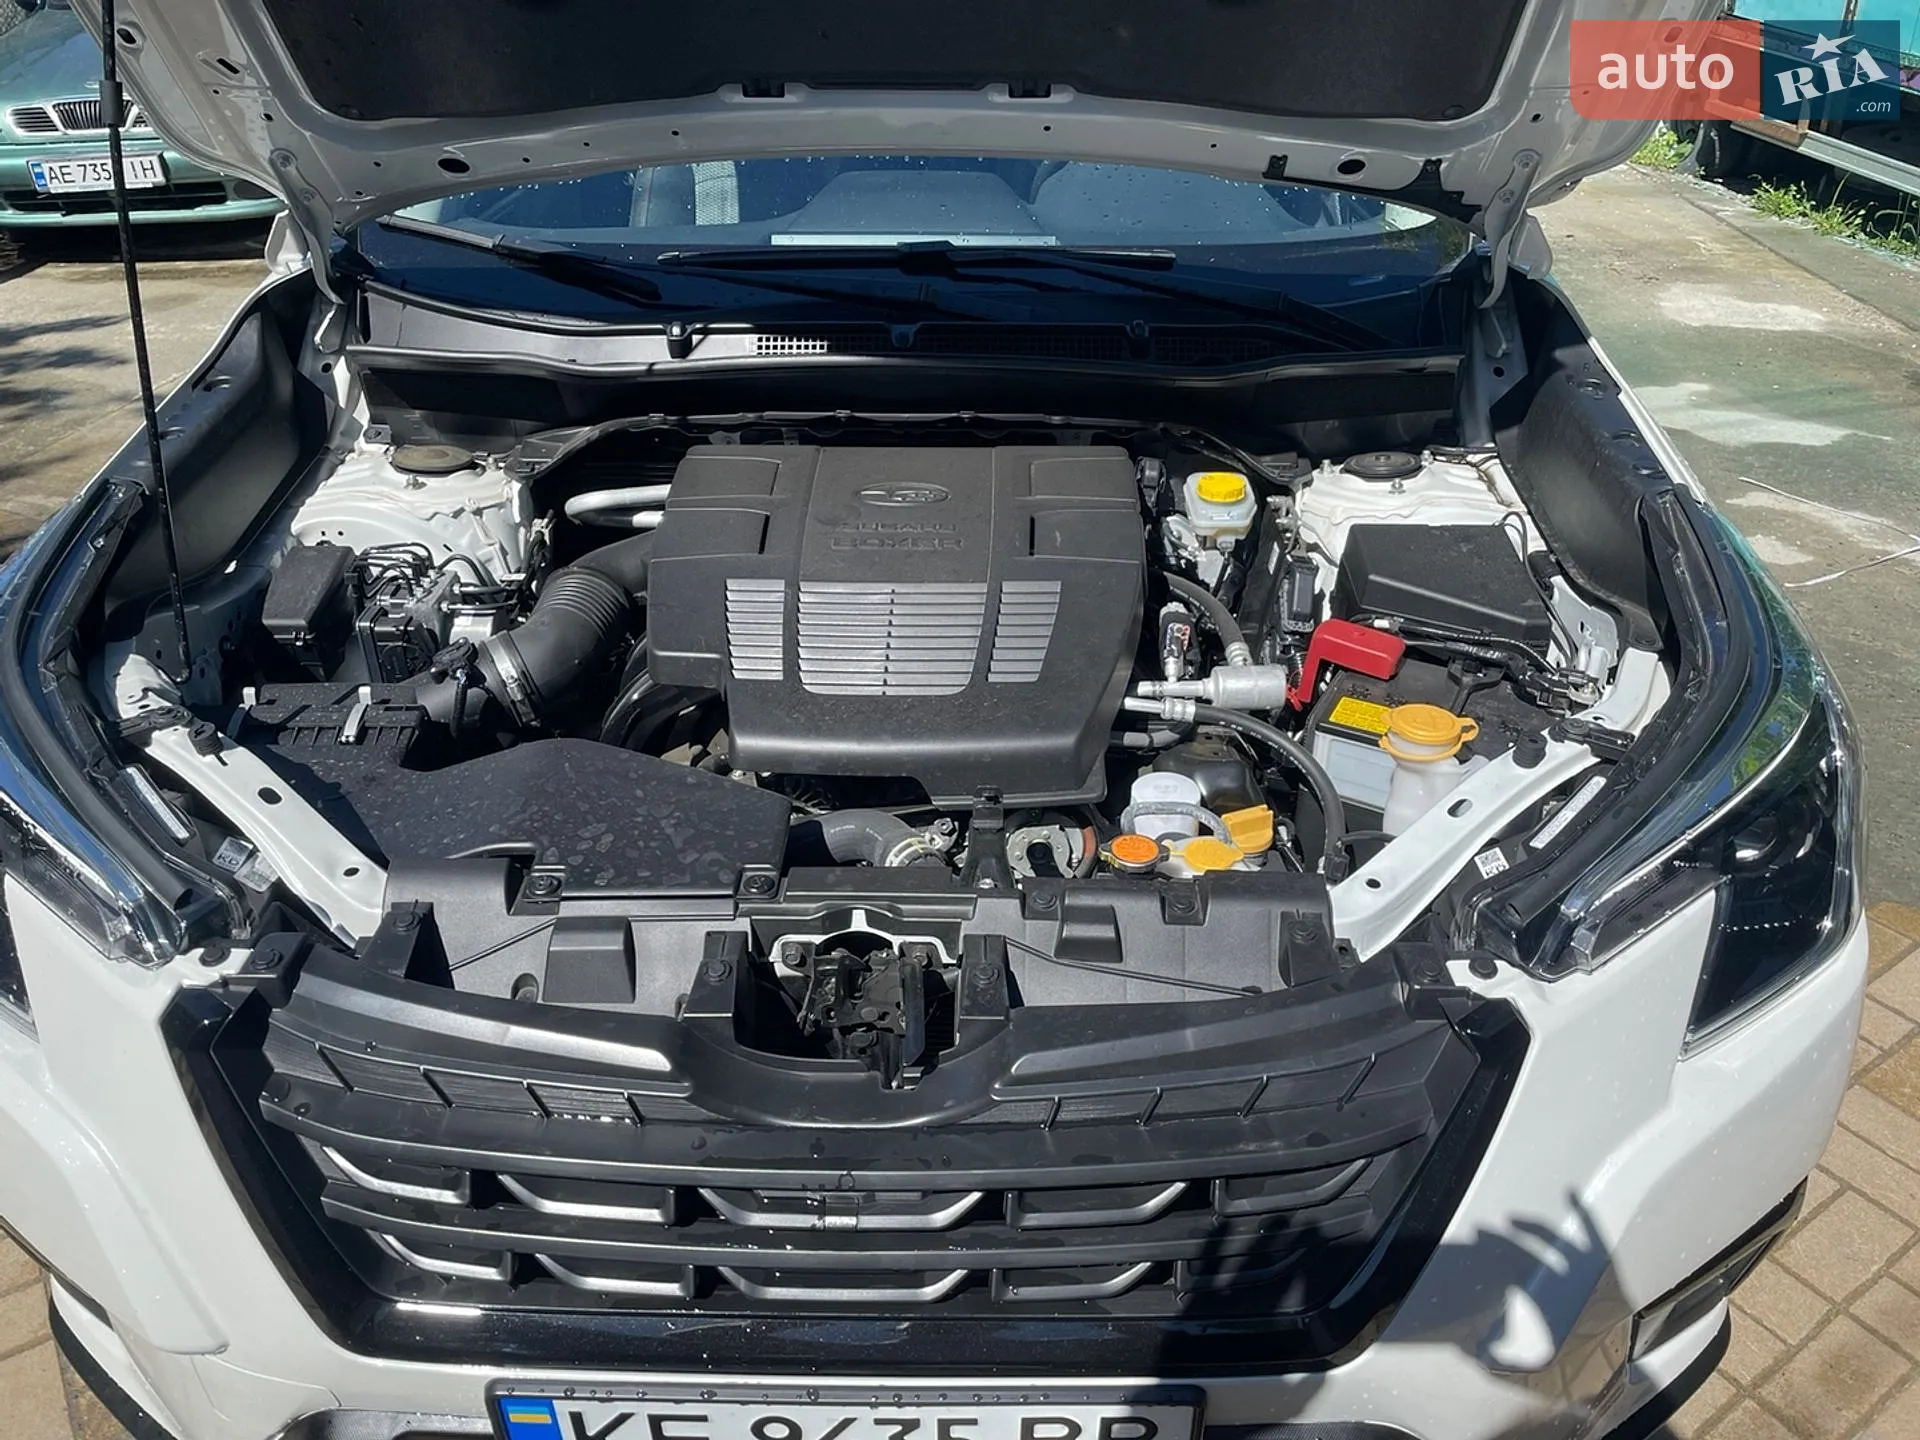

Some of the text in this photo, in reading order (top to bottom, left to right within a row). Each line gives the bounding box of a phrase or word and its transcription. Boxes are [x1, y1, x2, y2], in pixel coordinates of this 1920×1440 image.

[48, 164, 76, 185] AE
[77, 162, 113, 182] 735
[130, 159, 157, 179] IH
